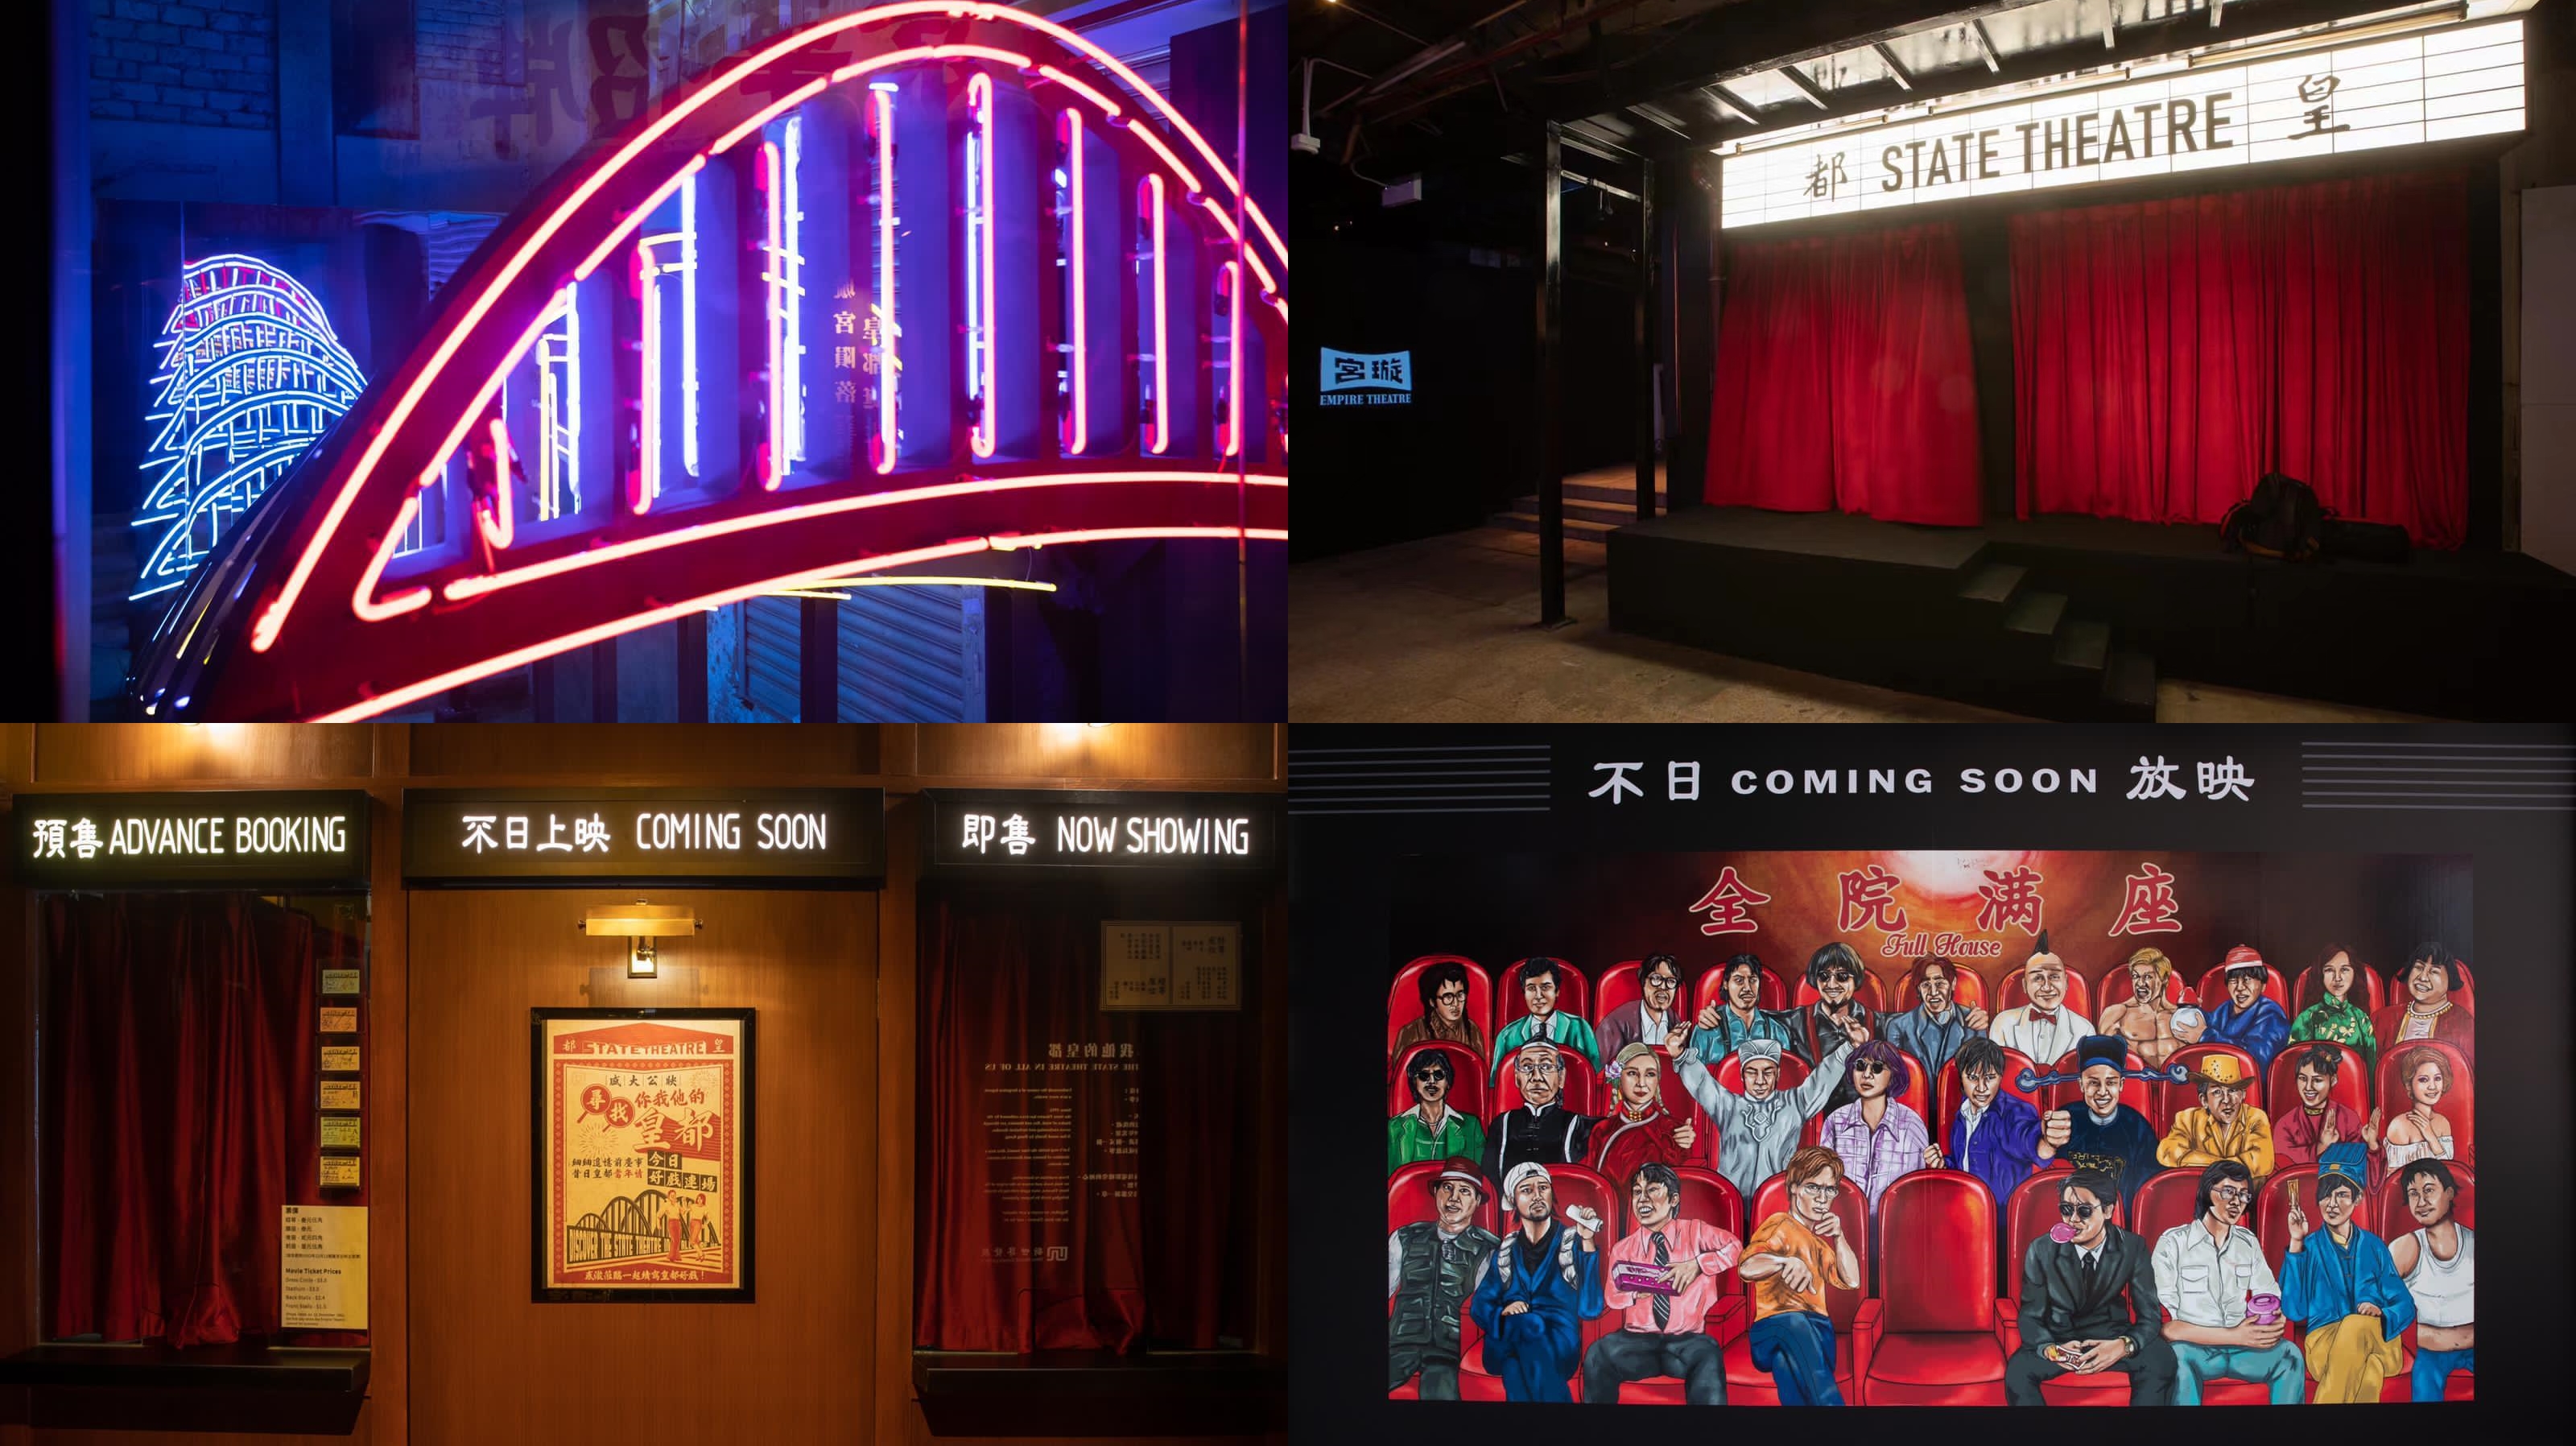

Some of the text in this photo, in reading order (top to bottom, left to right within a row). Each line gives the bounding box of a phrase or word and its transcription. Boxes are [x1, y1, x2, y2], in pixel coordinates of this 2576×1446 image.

[2287, 74, 2351, 140] 皇
[1881, 91, 2234, 192] STATE THEATRE
[1804, 153, 1848, 203] 都
[1320, 394, 1411, 406] EMPIRE THEATRE
[1588, 760, 1701, 804] 不日
[1731, 768, 2097, 795] COMING SOON
[2125, 755, 2256, 801] 放映
[32, 818, 103, 858] 預售
[109, 816, 345, 855] ADVANCE BOOKING
[462, 812, 611, 853] 不日上映
[637, 813, 826, 850] COMING SOON
[962, 813, 1036, 855] 即售
[1057, 816, 1249, 854] NOW SHOWING
[1880, 932, 2002, 958] Full House
[582, 1040, 706, 1055] STATE THEATRE
[634, 1089, 705, 1108] 你我他的
[634, 1108, 714, 1153] 皇都
[648, 1151, 679, 1167] 今日
[601, 1232, 612, 1258] THE
[614, 1233, 634, 1257] STATE
[635, 1236, 663, 1255] THEATRE
